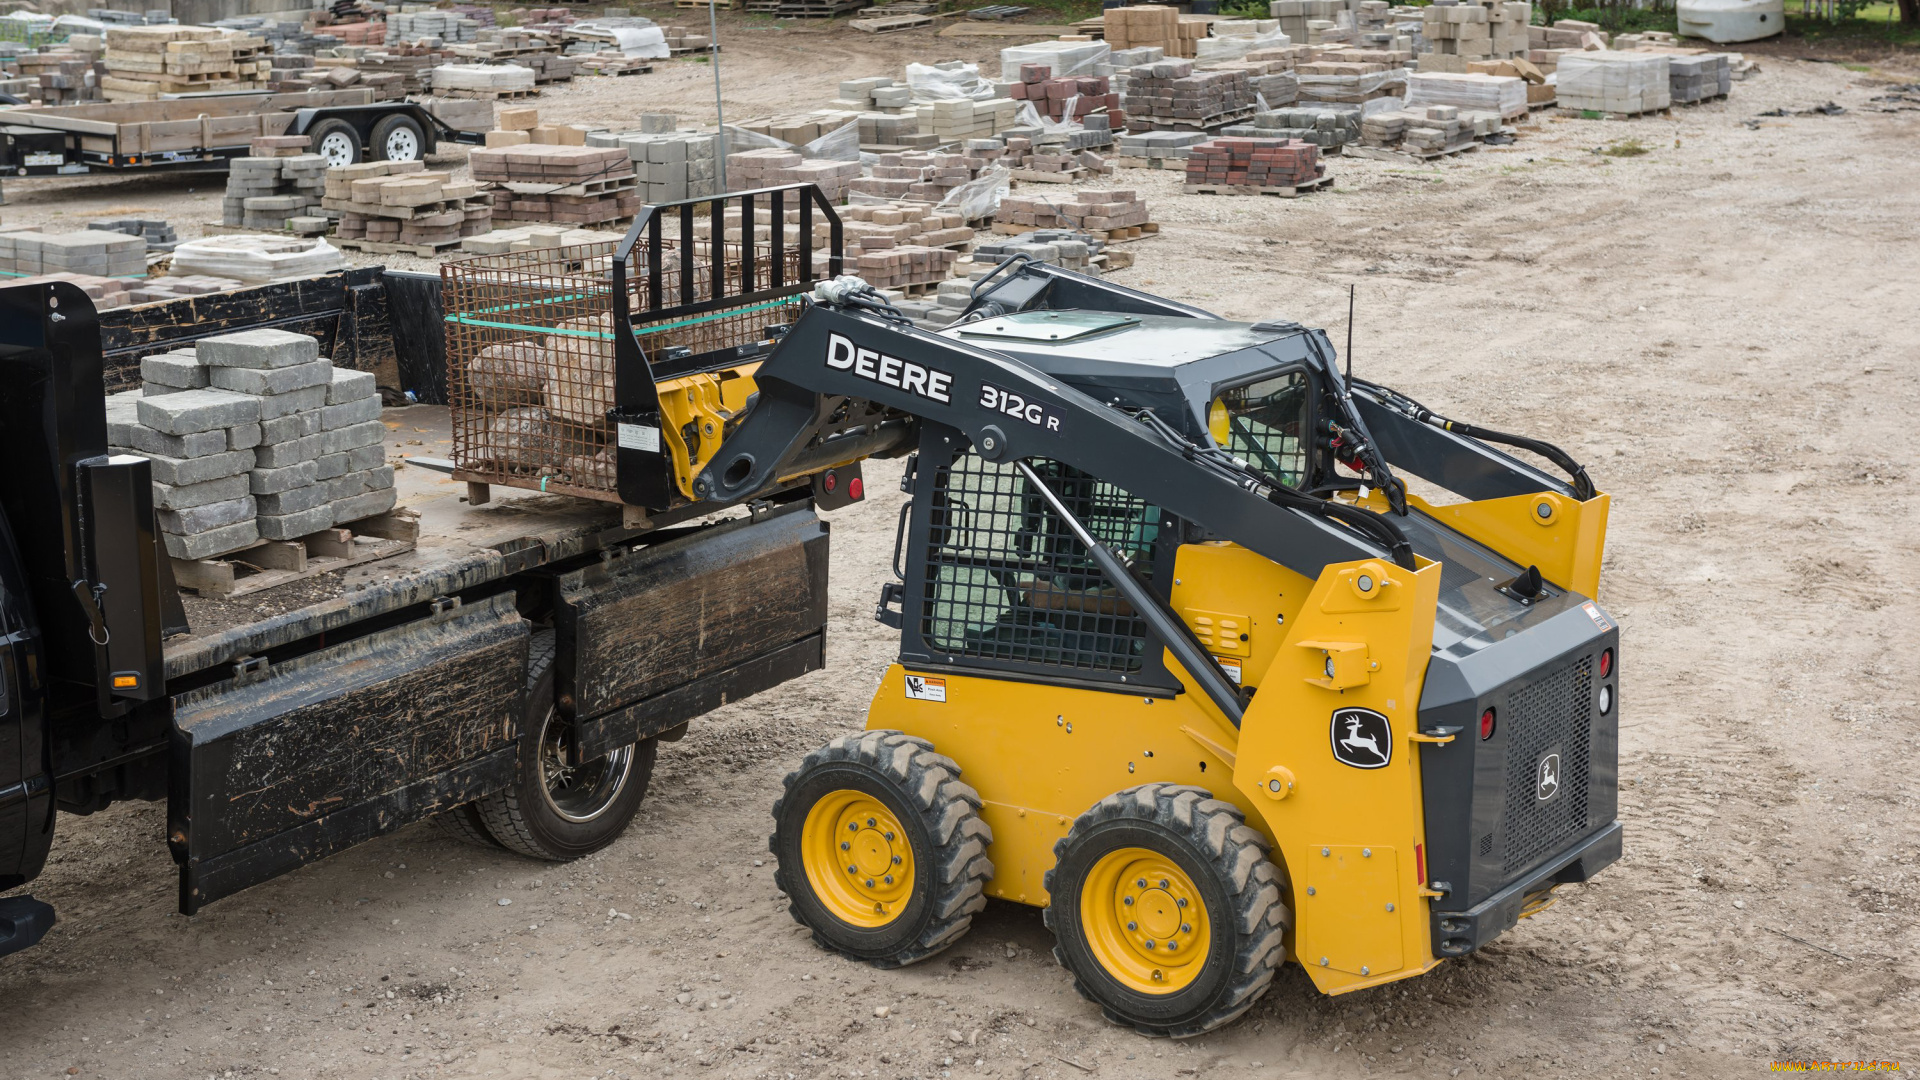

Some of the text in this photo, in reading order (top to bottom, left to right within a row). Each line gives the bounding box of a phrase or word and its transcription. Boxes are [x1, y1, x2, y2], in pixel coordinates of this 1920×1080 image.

[826, 332, 953, 404] DEERE
[980, 385, 1060, 432] 312G R
